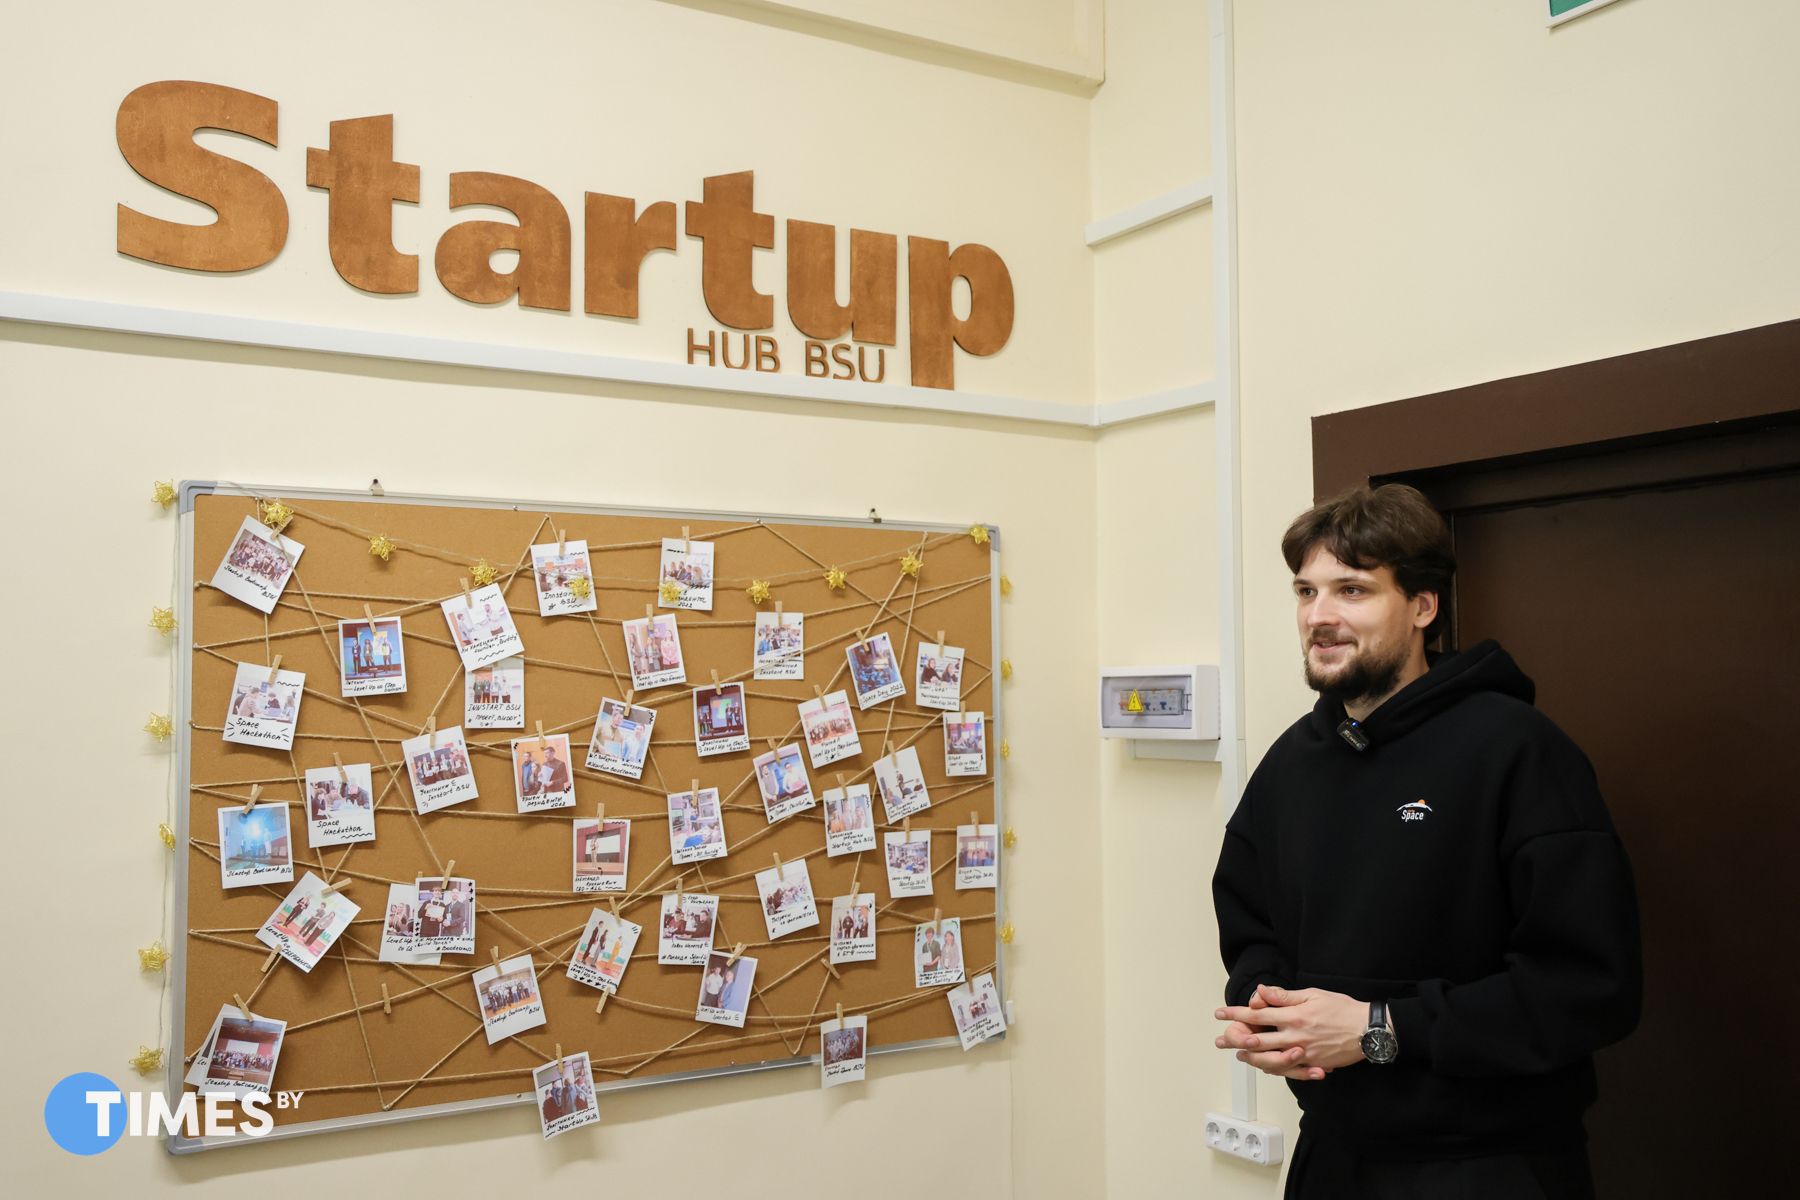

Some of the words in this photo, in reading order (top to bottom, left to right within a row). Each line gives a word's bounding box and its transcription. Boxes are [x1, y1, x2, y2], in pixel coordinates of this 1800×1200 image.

[116, 80, 1015, 390] Startup
[687, 327, 782, 375] HUB
[805, 340, 886, 384] BSU
[236, 717, 260, 729] Space
[240, 729, 281, 741] Hackathon
[1401, 809, 1424, 822] Space
[317, 820, 339, 828] Space
[323, 826, 362, 836] Hackathon
